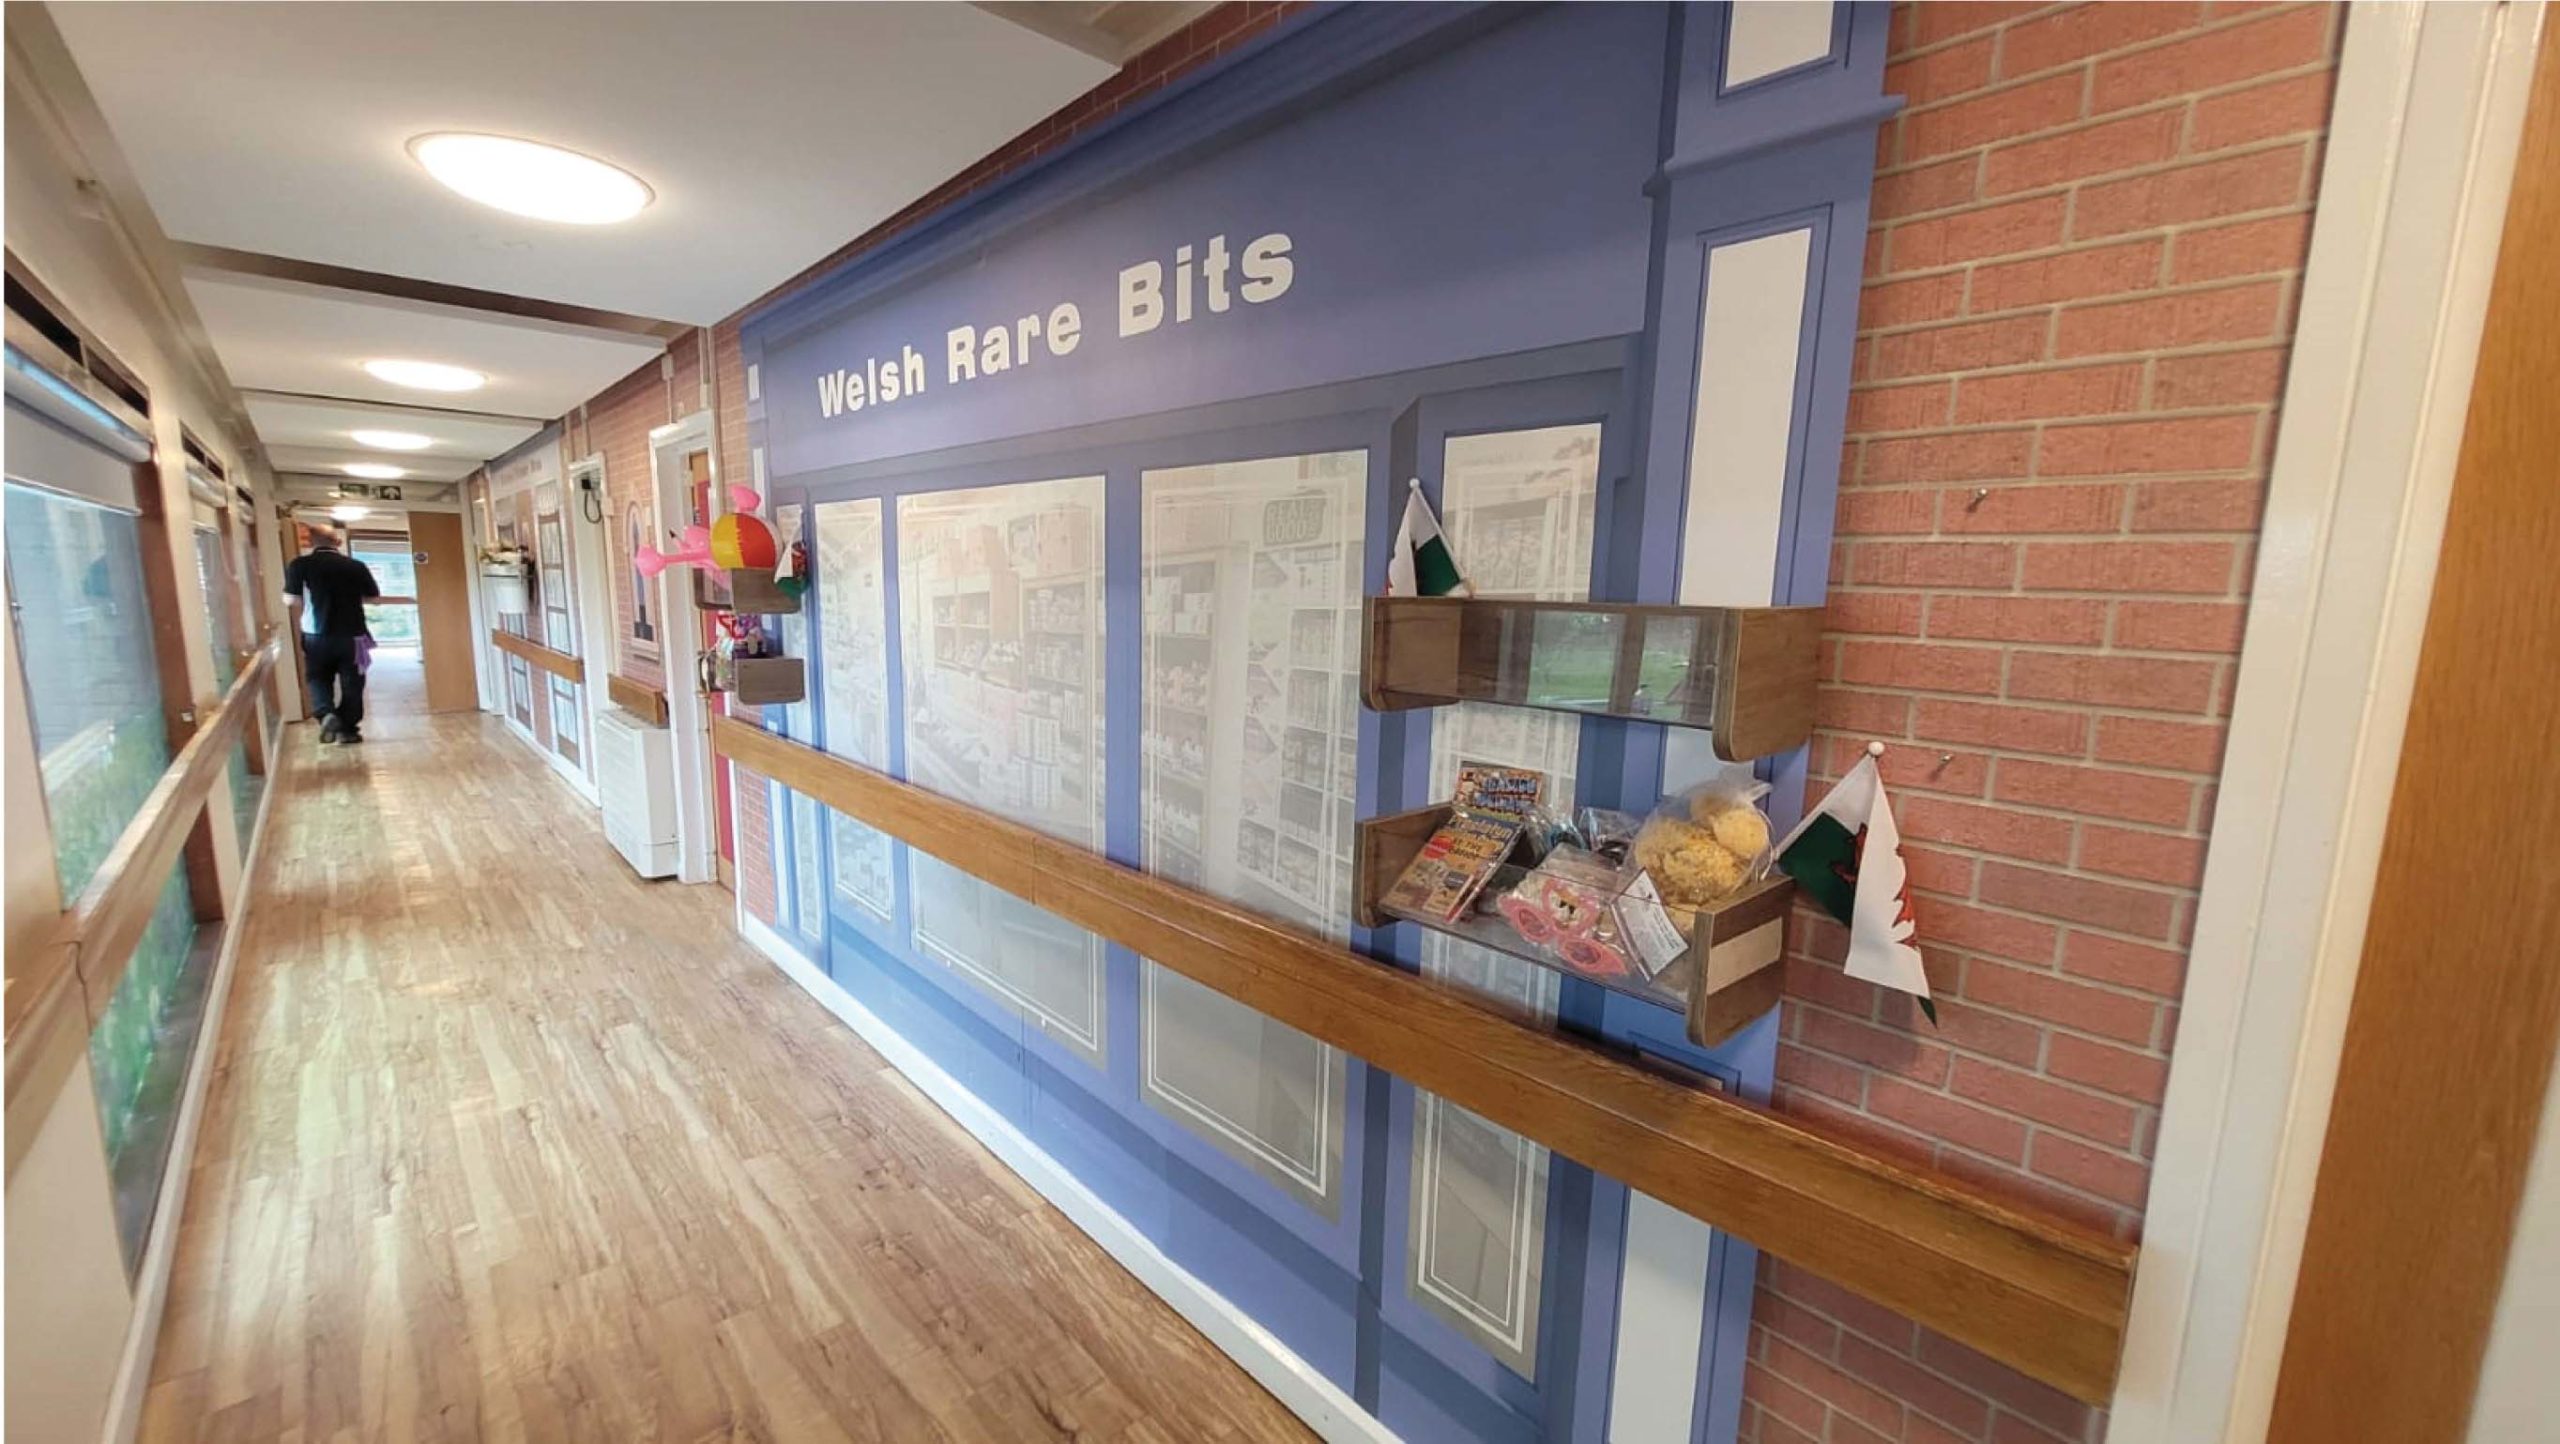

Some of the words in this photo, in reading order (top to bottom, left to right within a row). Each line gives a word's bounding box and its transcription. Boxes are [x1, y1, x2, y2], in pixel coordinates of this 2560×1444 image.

[817, 345, 925, 418] Welsh
[947, 302, 1082, 384] Rare
[1118, 233, 1294, 338] Bits
